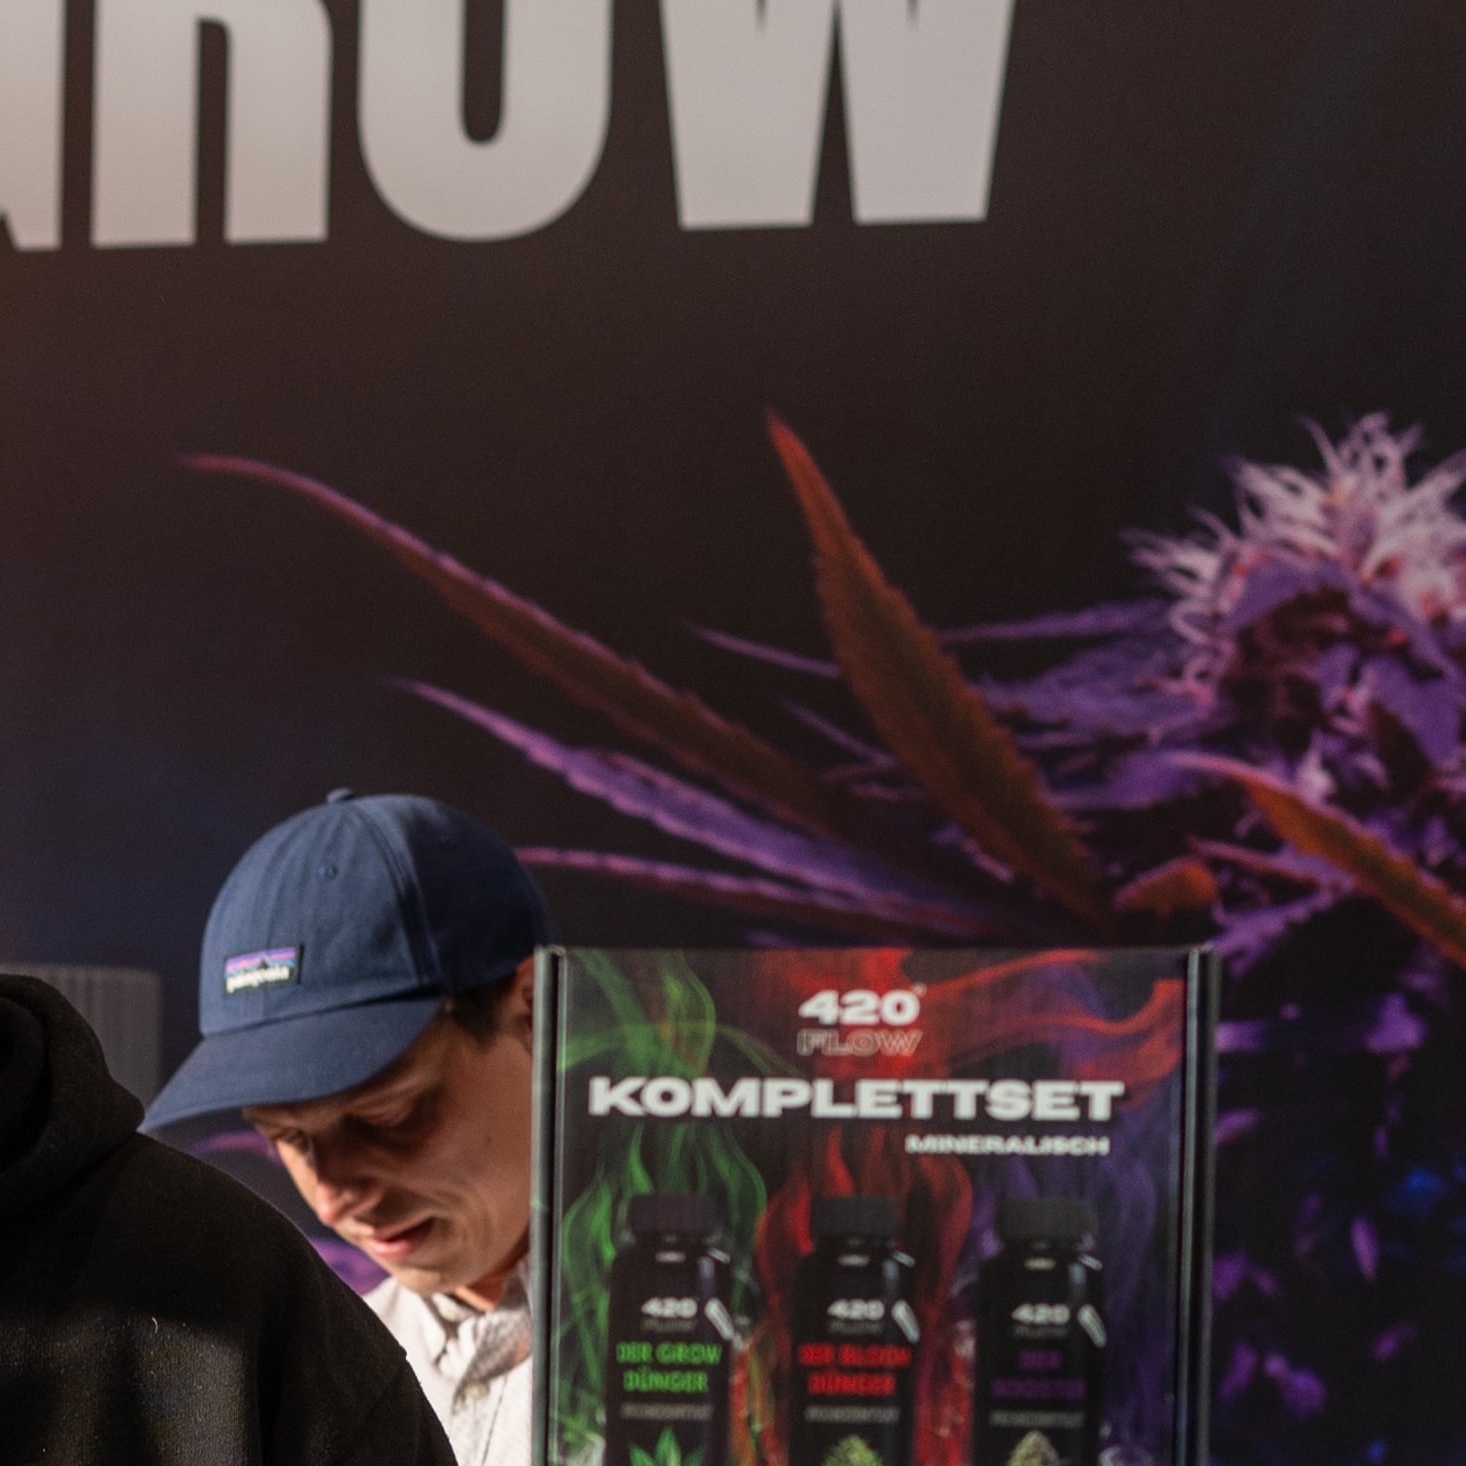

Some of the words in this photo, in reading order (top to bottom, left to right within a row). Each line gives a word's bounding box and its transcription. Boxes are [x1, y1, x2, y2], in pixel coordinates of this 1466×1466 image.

[797, 988, 921, 1026] 420
[796, 1029, 922, 1057] FLOW
[588, 1076, 1125, 1121] KOMPLETTSET
[905, 1133, 1110, 1157] MINERALISCH
